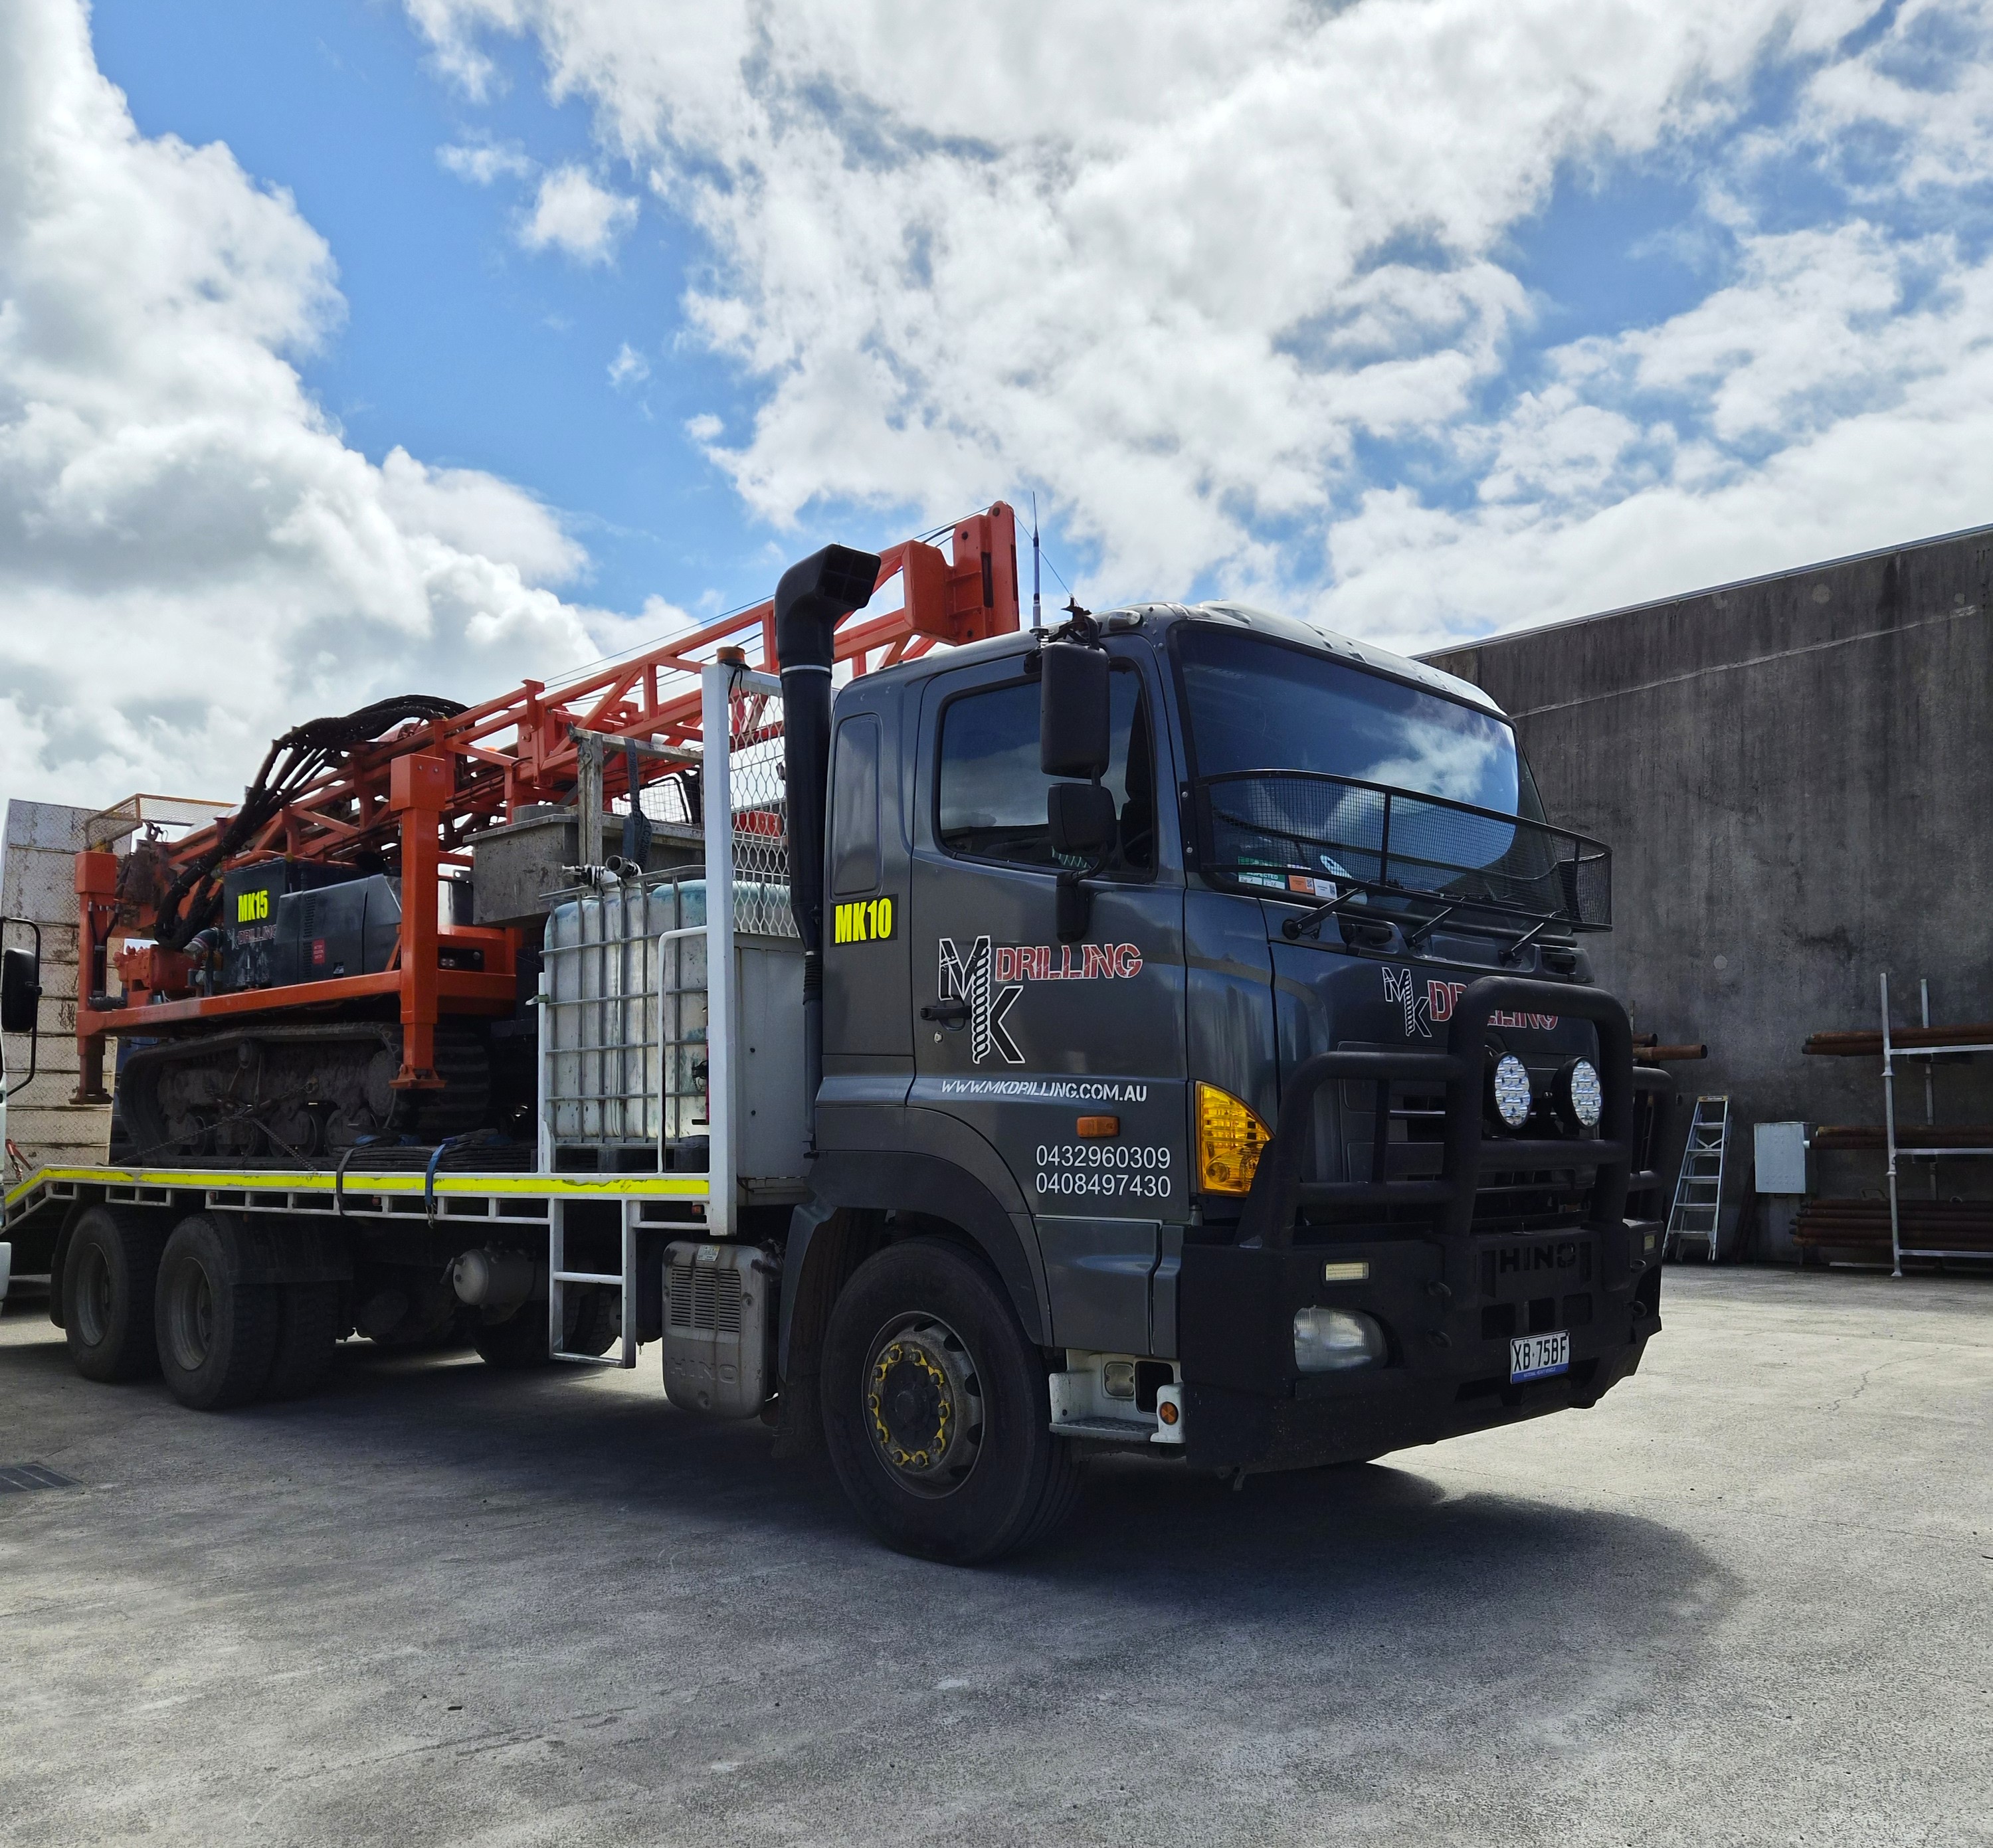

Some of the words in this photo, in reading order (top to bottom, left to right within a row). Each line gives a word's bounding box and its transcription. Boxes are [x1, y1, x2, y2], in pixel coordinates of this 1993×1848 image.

[238, 889, 268, 923] MK15
[835, 898, 892, 943] MK10
[939, 935, 1025, 1064] MK
[995, 943, 1143, 982] DRILLING
[941, 1080, 1147, 1102] WWW.MKDRILLING.COM.AU
[1036, 1145, 1171, 1169] 0432960309
[1036, 1172, 1171, 1197] 0408497430
[1500, 1242, 1576, 1273] HINO
[670, 1357, 738, 1384] HINO
